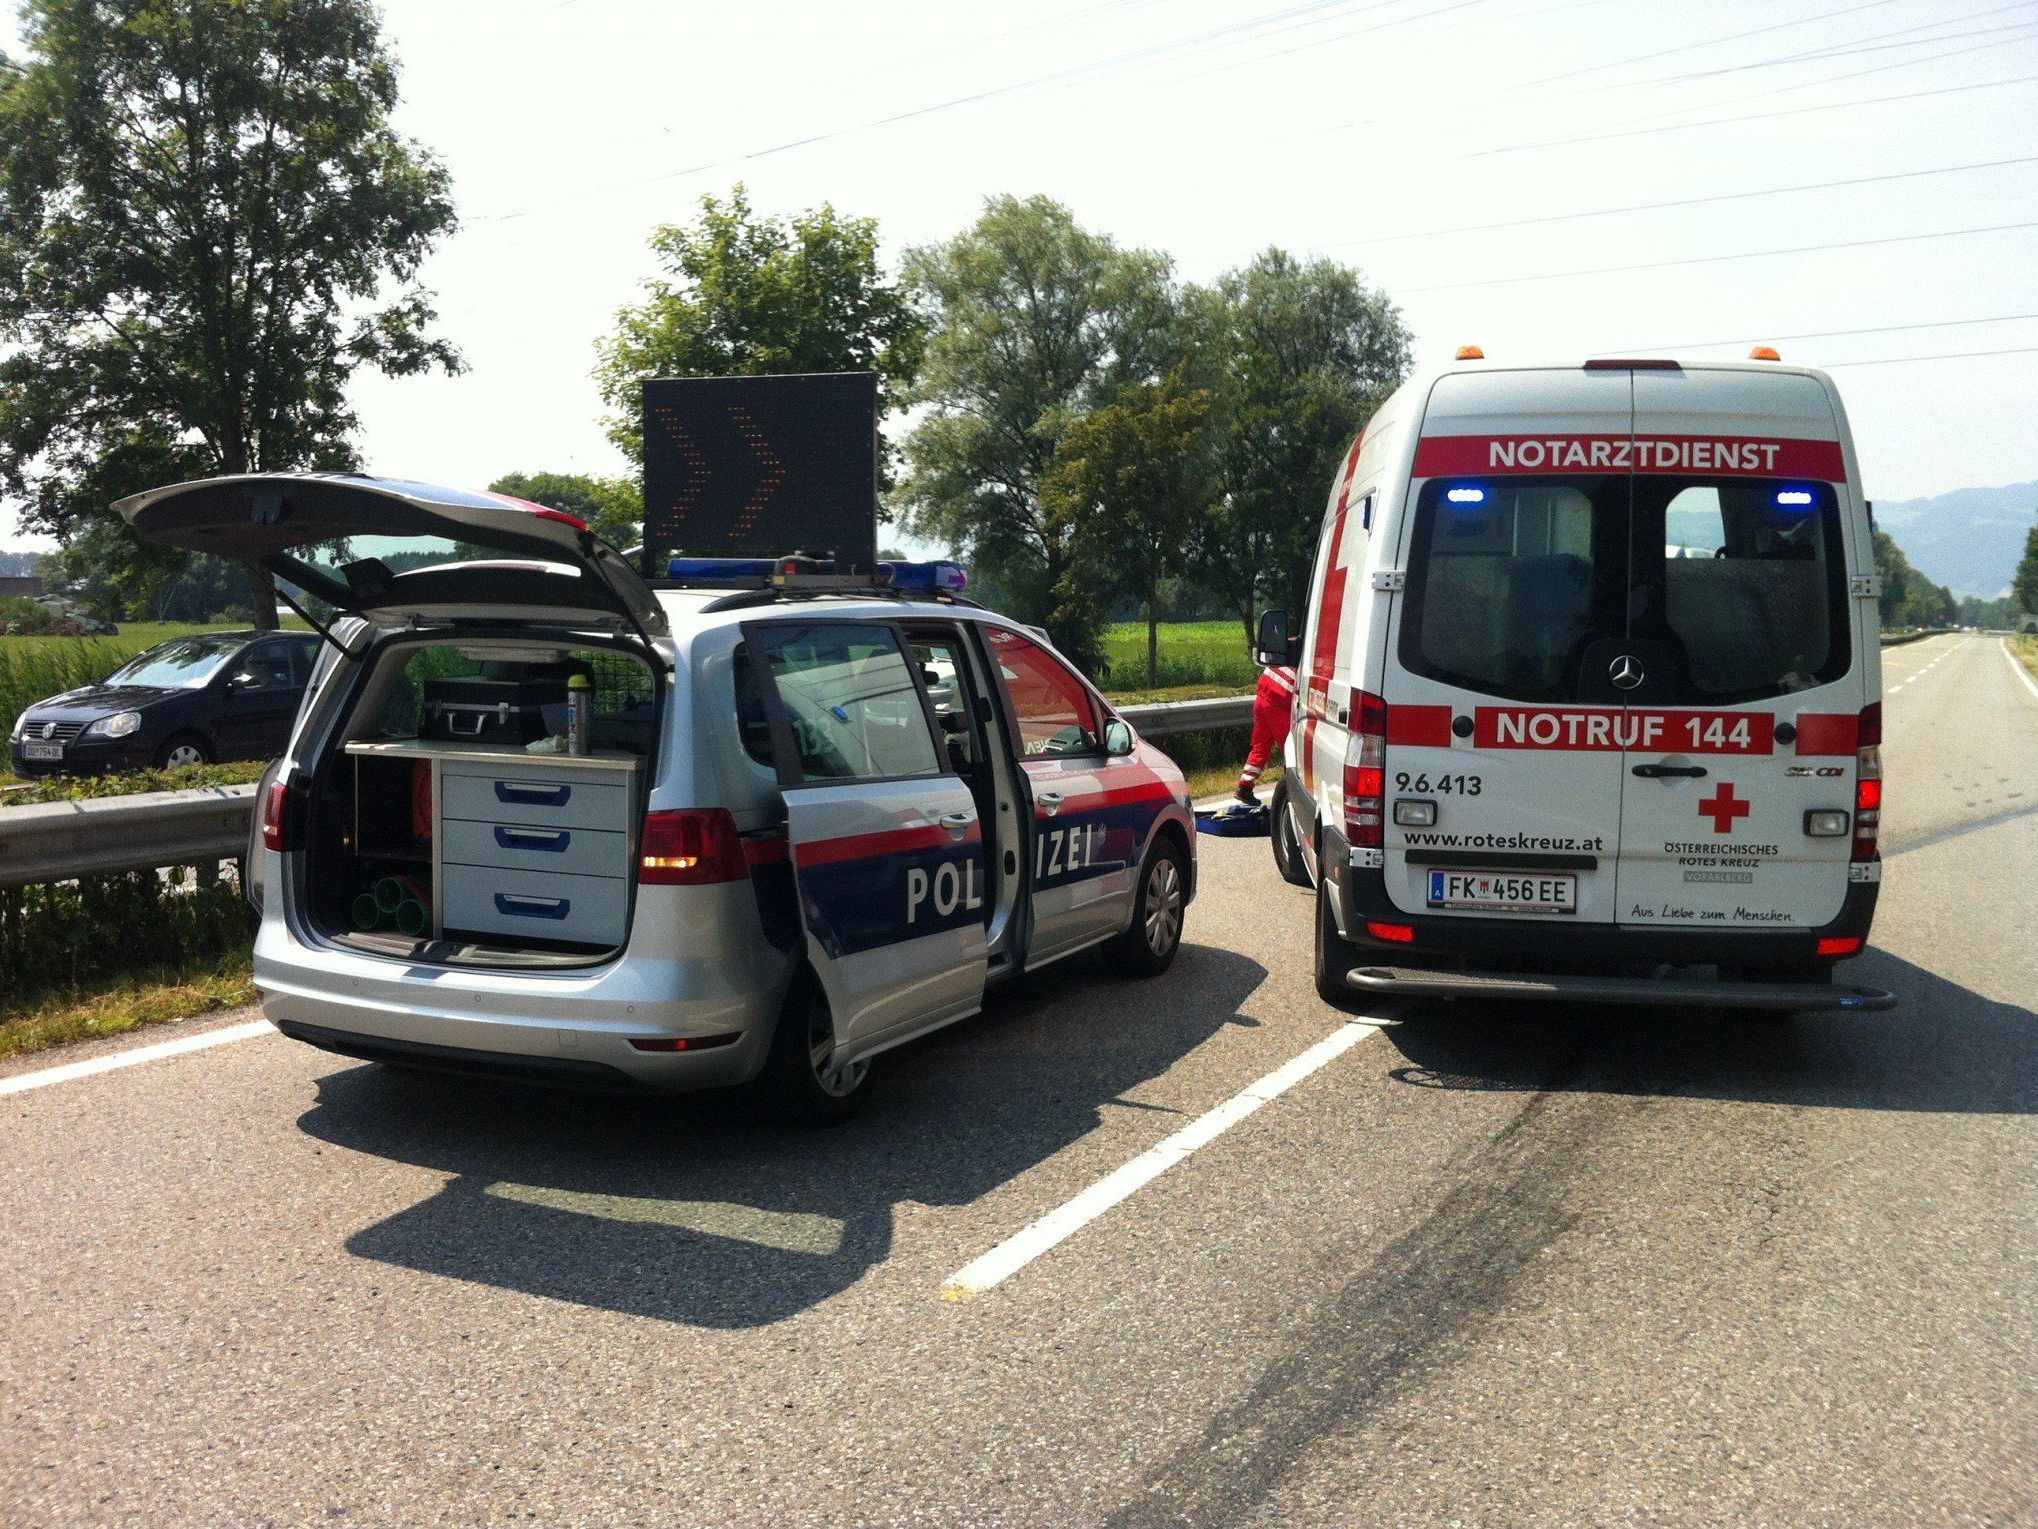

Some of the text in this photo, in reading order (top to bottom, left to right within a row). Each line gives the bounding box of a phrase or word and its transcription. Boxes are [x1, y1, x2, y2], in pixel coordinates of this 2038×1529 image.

[1489, 440, 1780, 470] NOTARZTDIENST
[1497, 712, 1752, 749] NOTRUF 144
[1395, 772, 1482, 796] 9.6.413
[1404, 832, 1603, 851] www.roteskreuz.at
[1664, 842, 1778, 855] ÖSTERREICHISCHES
[1678, 857, 1760, 867] ROTES KREUZ
[1631, 904, 1654, 918] Aus
[1662, 904, 1695, 919] Liebe
[1700, 910, 1726, 920] zum
